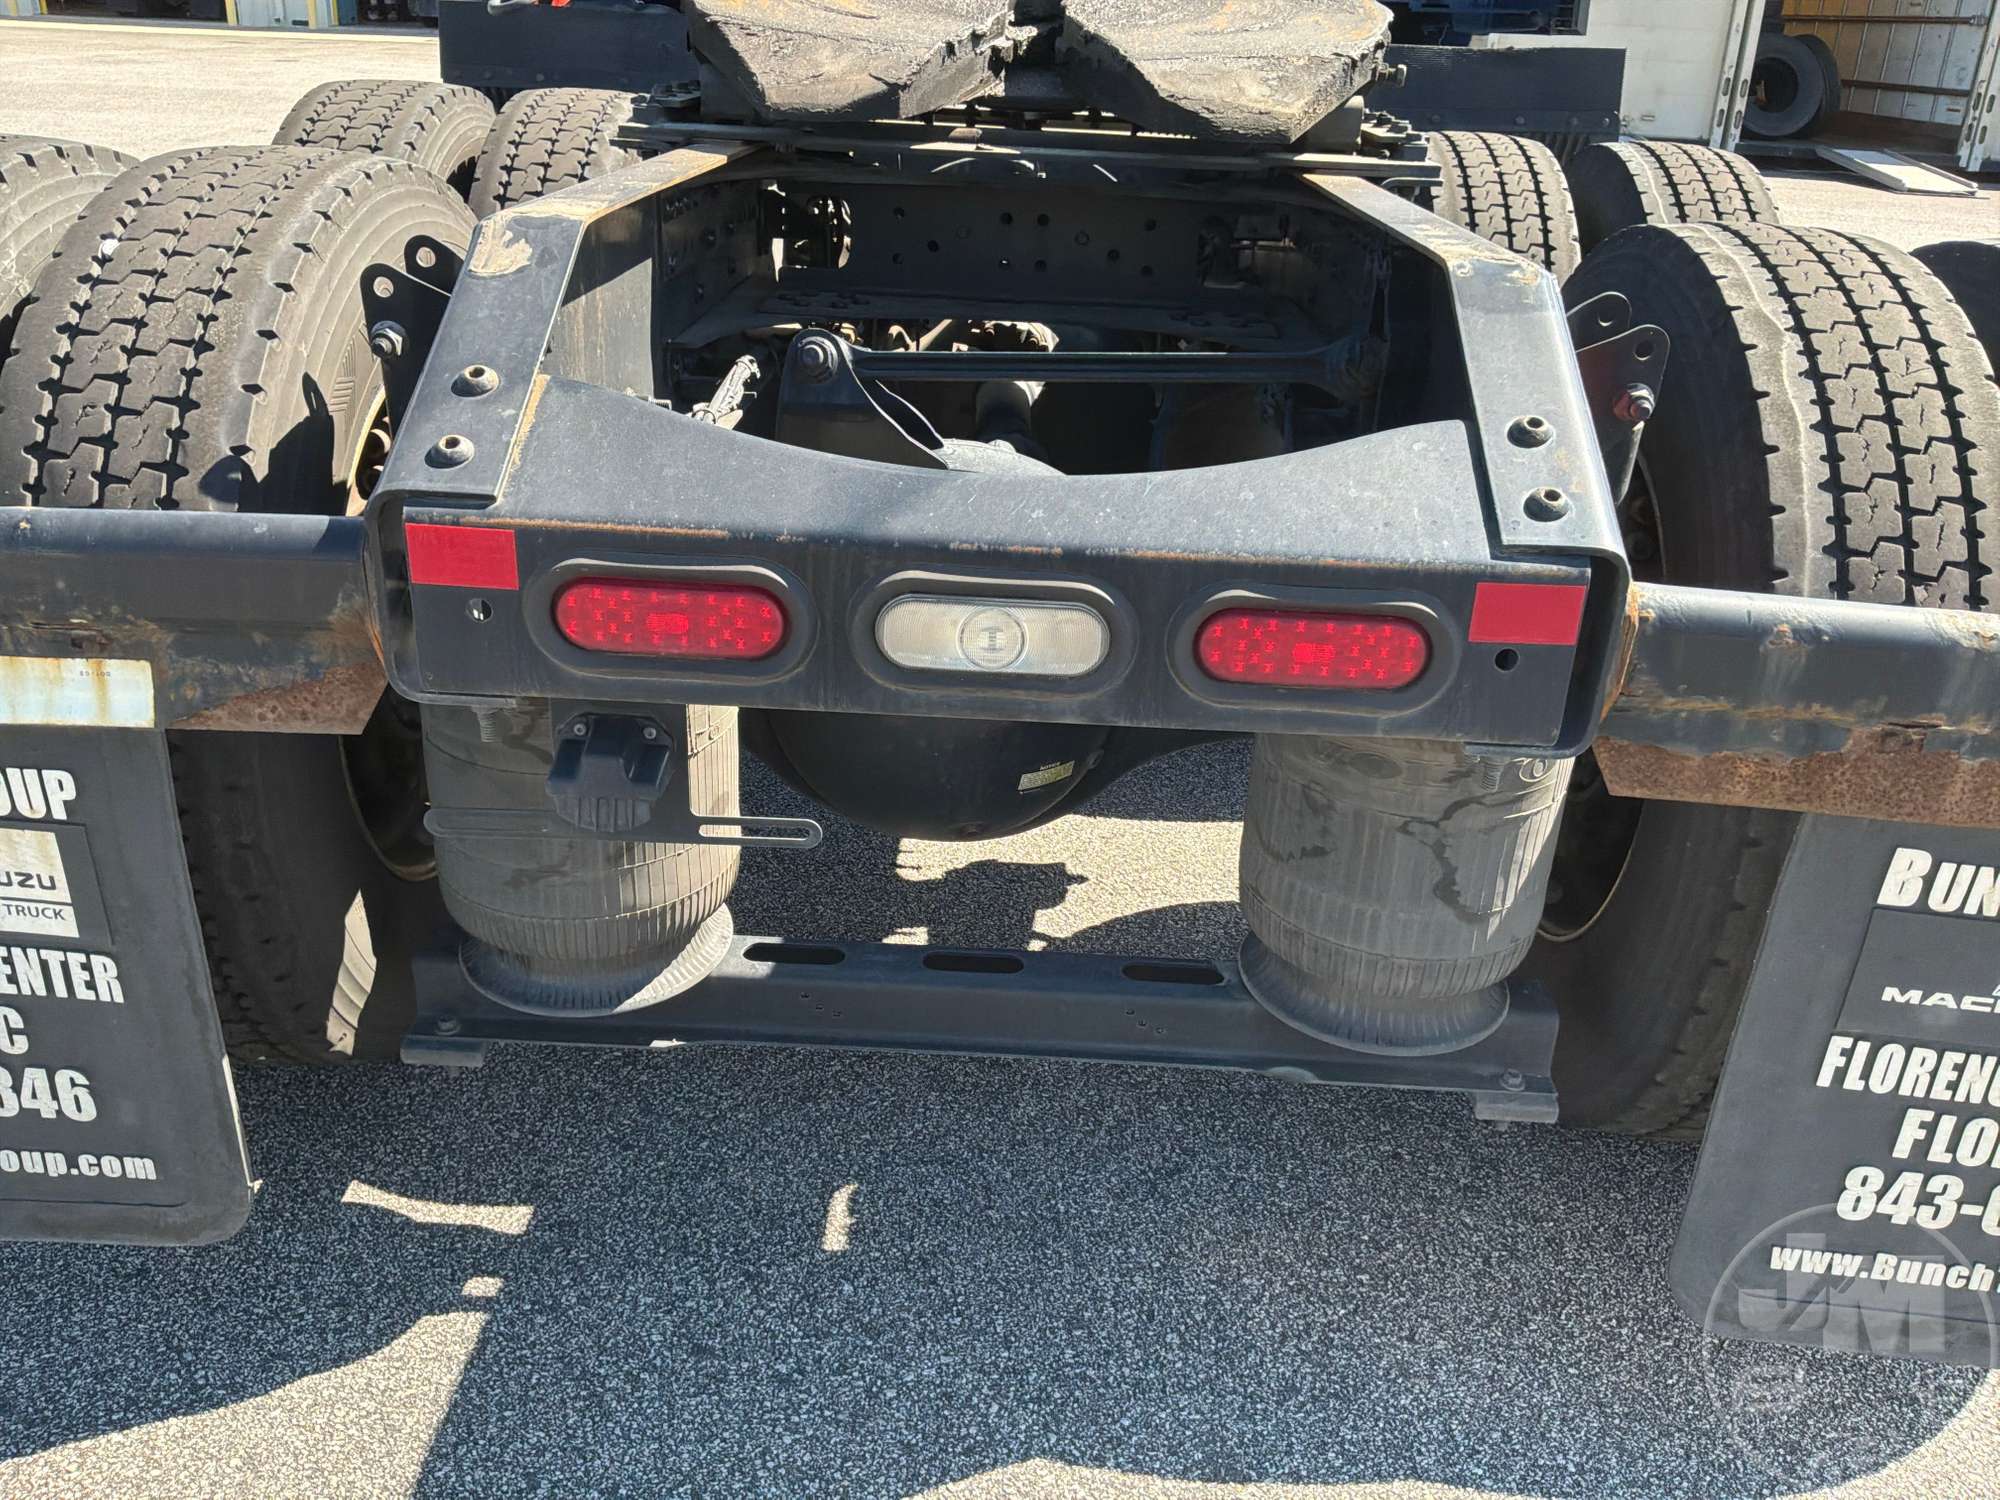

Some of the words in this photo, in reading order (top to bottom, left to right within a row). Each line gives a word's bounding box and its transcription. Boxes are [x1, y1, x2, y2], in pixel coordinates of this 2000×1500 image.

[2, 903, 66, 920] TRUCK
[1881, 986, 2000, 1014] MAC
[1892, 1108, 2000, 1169] FLO
[0, 1149, 157, 1180] oup.com
[1770, 1246, 2000, 1293] www.Bunch
